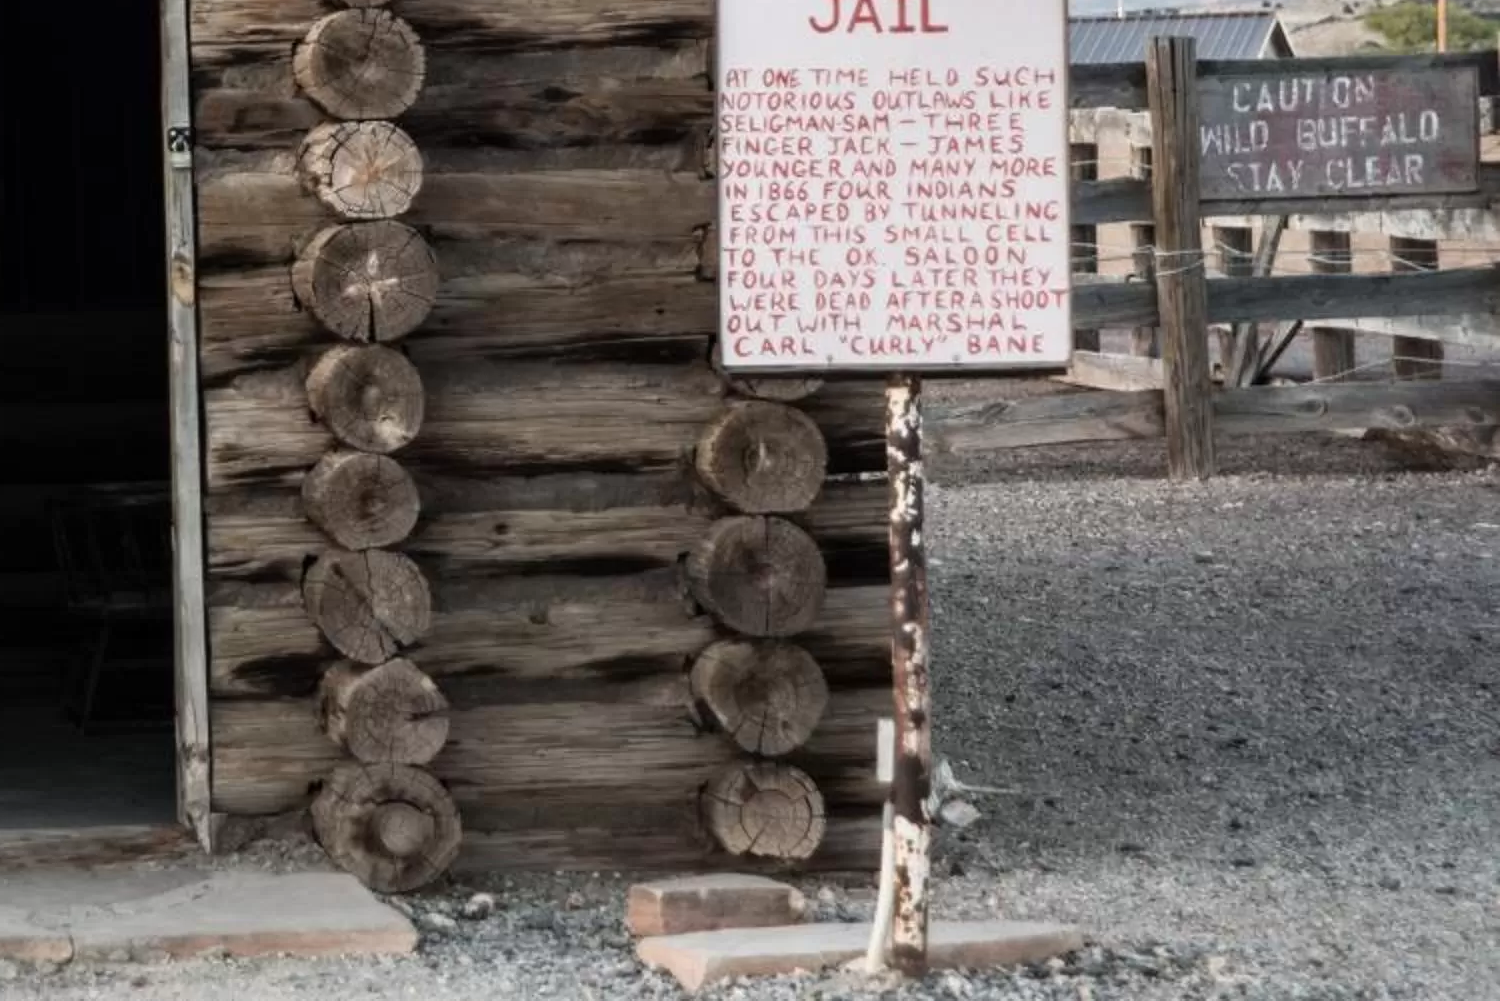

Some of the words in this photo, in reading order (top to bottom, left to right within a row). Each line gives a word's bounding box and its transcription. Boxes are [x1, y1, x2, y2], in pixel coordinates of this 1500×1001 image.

[726, 68, 749, 87] AT
[763, 69, 801, 88] ONE
[810, 68, 869, 87] TIME
[890, 66, 959, 87] HELD
[975, 66, 1055, 87] SUCH
[720, 91, 855, 111] NOTORIOUS
[872, 90, 977, 110] OUTLAWS
[989, 90, 1052, 109] LIKE
[1233, 74, 1375, 112] CAUTION
[924, 112, 1024, 131] THREE
[1201, 120, 1269, 155] WILD
[1296, 110, 1439, 151] BUFFALO
[721, 136, 813, 156] FINGER
[828, 136, 891, 156] JACK
[930, 135, 1024, 154] JAMES
[721, 159, 844, 179] YOUNGER
[853, 158, 897, 178] AND
[910, 157, 977, 177] MANY
[990, 157, 1056, 176] MORE
[1227, 159, 1304, 192] STAY
[1326, 154, 1424, 189] CLEAR
[726, 183, 749, 200] IN
[759, 181, 808, 201] 1866
[823, 181, 892, 200] FOUR
[907, 179, 1017, 198] INDIANS
[730, 203, 849, 223] ESCAPED
[865, 202, 891, 222] BY
[902, 201, 1059, 222] TUNNELING
[729, 225, 796, 244] FROM
[811, 225, 866, 244] THIS
[885, 223, 971, 243] SMALL
[986, 223, 1052, 242] CELL
[724, 248, 755, 267] TO
[773, 248, 821, 267] THE
[845, 247, 877, 267] OK
[904, 246, 1027, 266] SALOON
[727, 269, 796, 289] FOUR
[814, 270, 877, 288] DAYS
[891, 269, 978, 288] LATER
[988, 268, 1051, 286] THEY
[729, 293, 801, 312] WERE
[815, 291, 871, 311] DEAD
[885, 290, 964, 310] AFTER
[727, 314, 787, 334] OUT
[797, 314, 861, 333] WITH
[886, 313, 1028, 332] MARSHAL
[733, 336, 815, 357] CARL
[967, 334, 1045, 354] BANE
